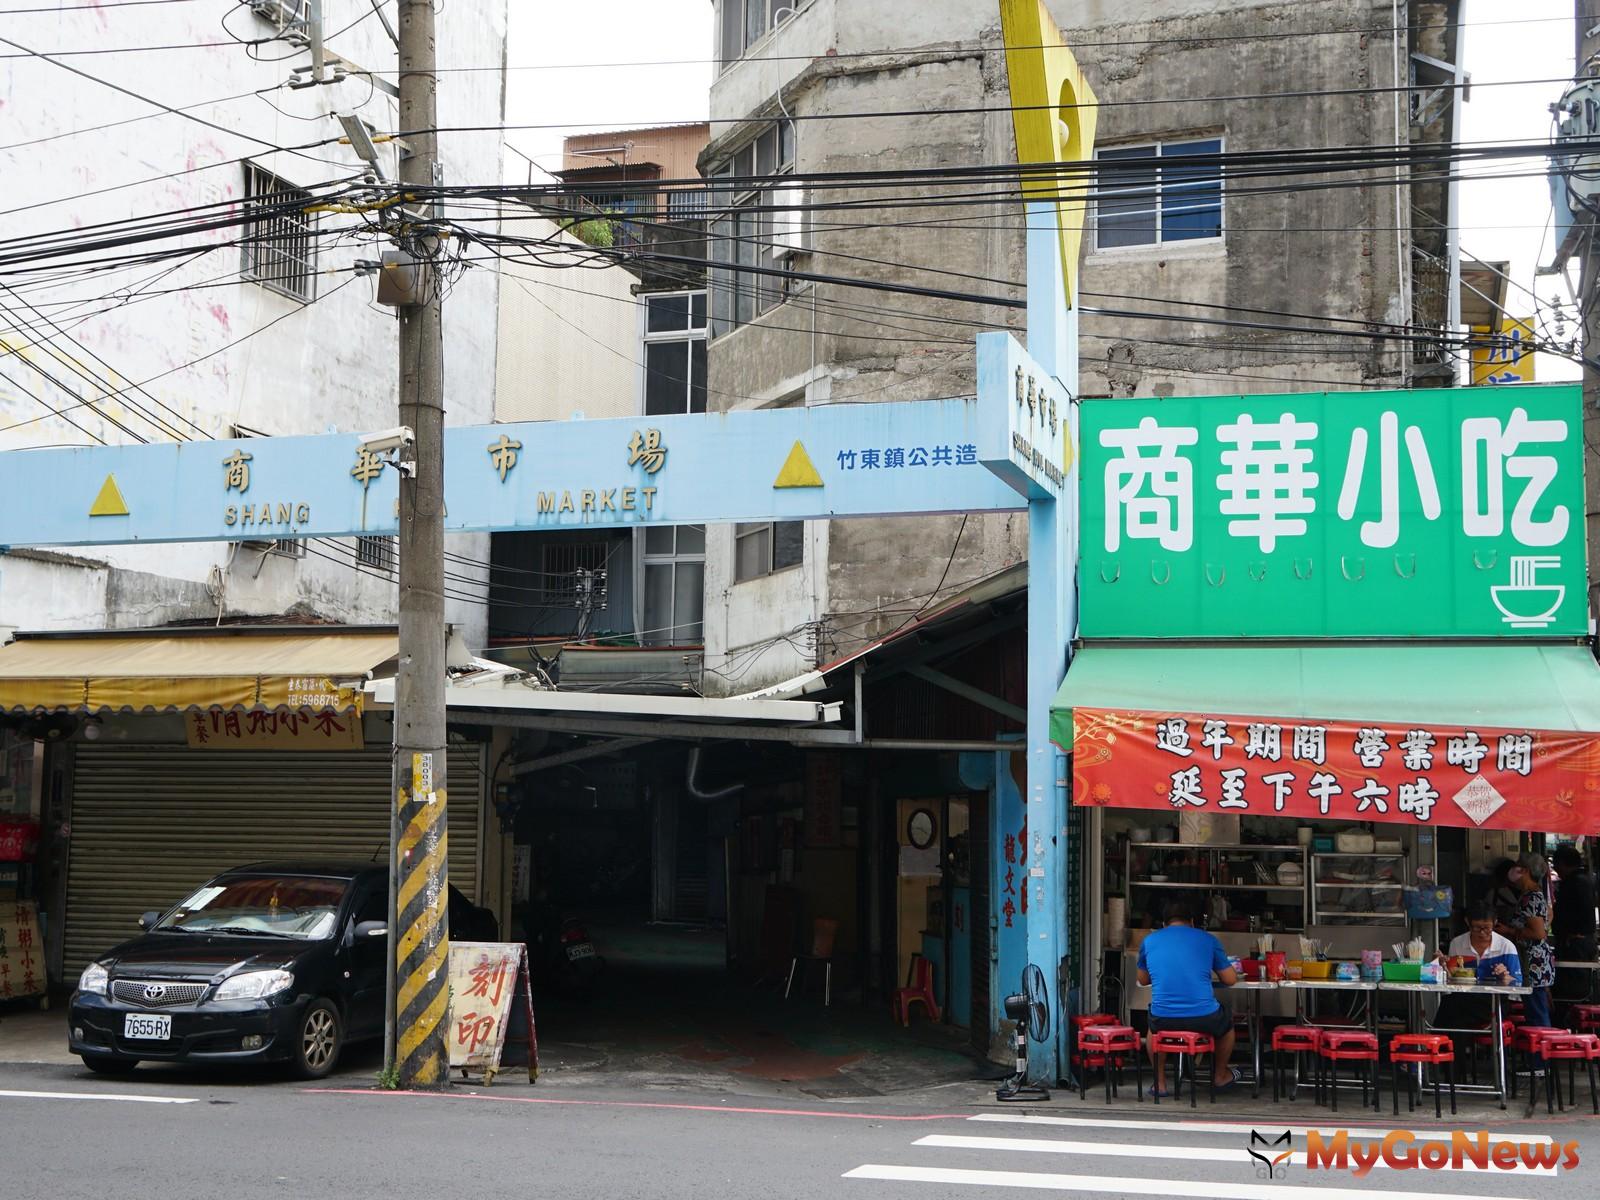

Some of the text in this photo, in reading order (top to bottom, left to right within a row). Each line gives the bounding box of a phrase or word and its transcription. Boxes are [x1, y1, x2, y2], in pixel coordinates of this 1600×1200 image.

[837, 443, 977, 470] 竹東鎮公共造
[1099, 407, 1571, 554] 商華小吃
[224, 487, 657, 526] SHANG MARKET
[1155, 718, 1533, 776] 過年期間 營業時間
[1169, 767, 1439, 822] 延至下午六時
[1002, 833, 1017, 929] 龍文堂
[457, 954, 511, 1054] 刻印
